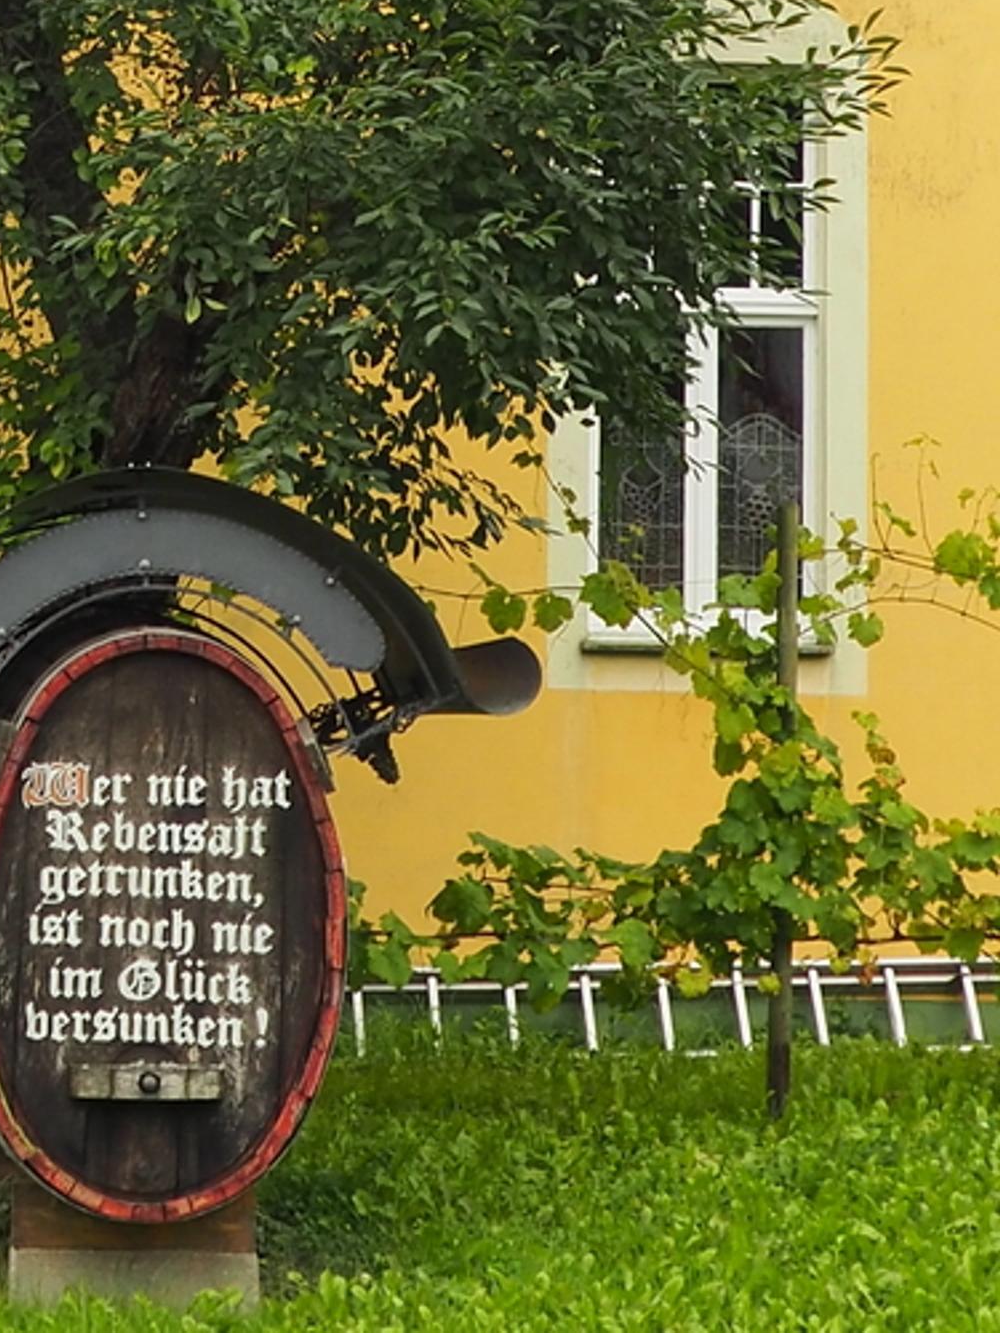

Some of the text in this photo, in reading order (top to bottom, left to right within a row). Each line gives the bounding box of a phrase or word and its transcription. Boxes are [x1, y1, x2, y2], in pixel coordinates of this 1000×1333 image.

[21, 760, 293, 813] Wer nie hat
[45, 810, 268, 859] Rebensaft
[38, 860, 265, 908] getrunken,
[28, 905, 275, 956] ist noch nie
[50, 957, 253, 1004] im Glück
